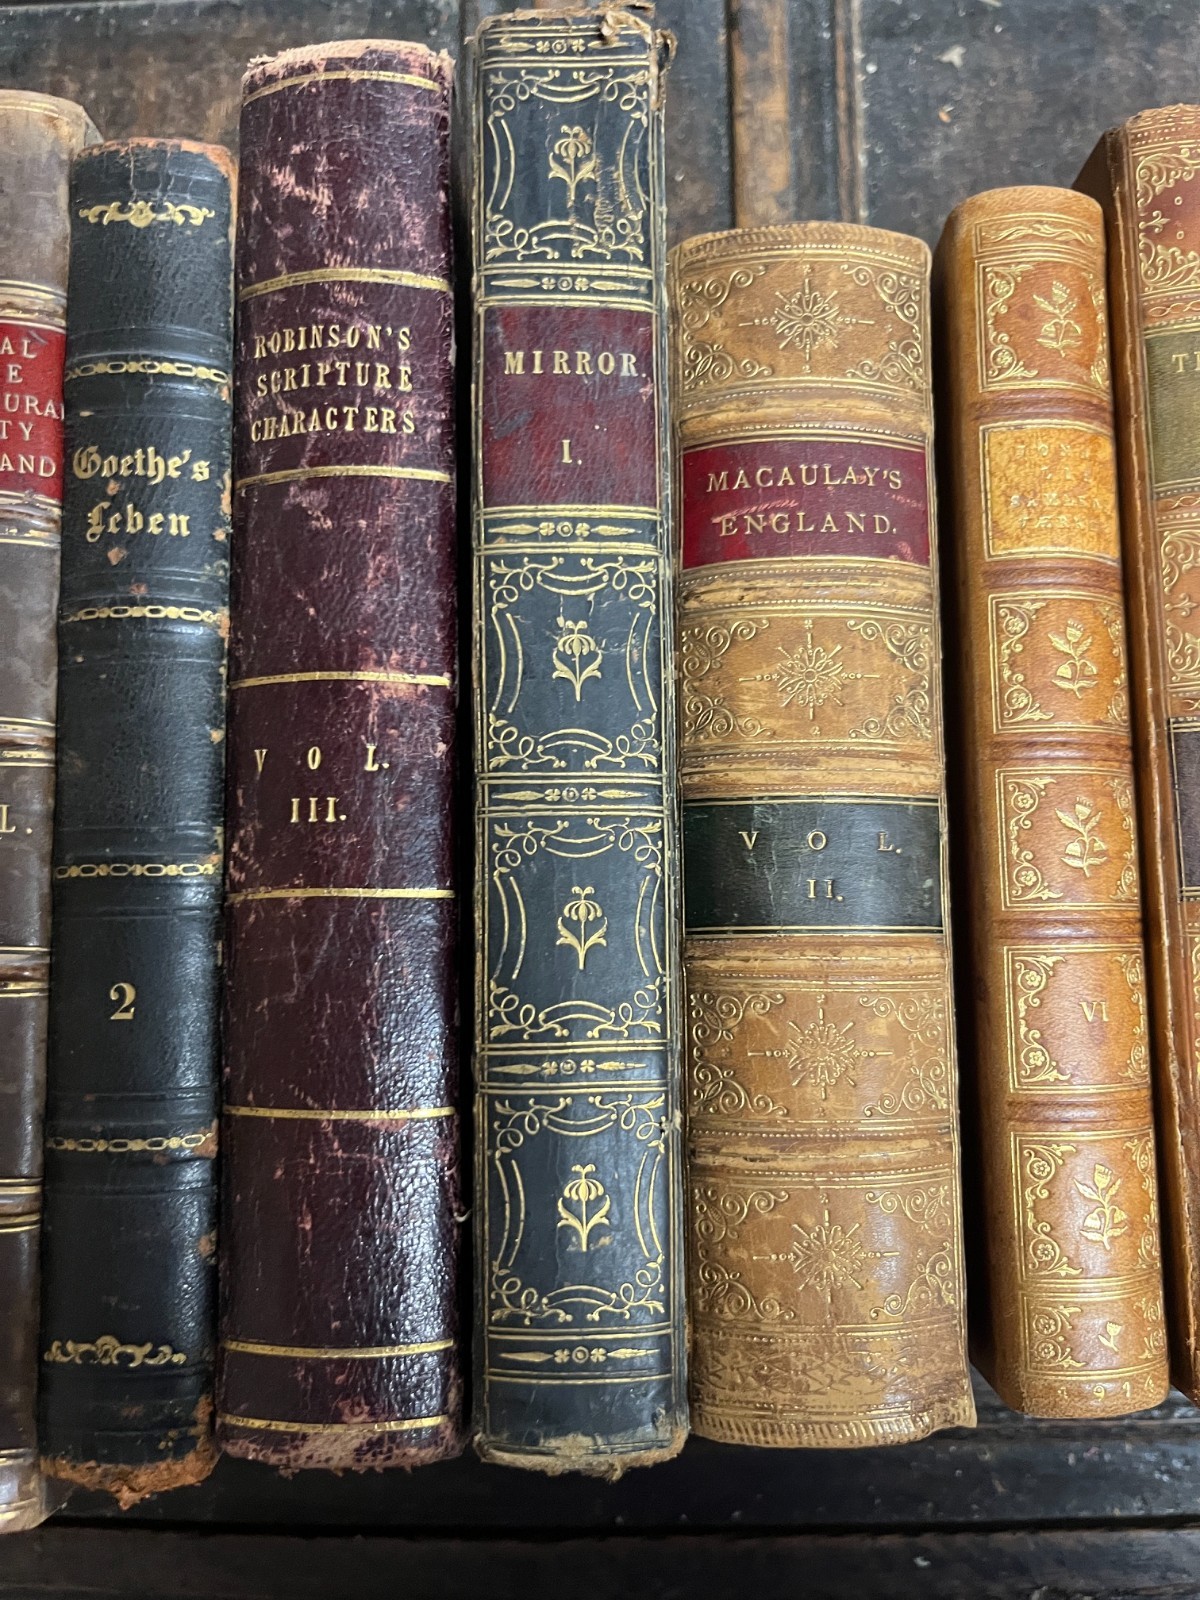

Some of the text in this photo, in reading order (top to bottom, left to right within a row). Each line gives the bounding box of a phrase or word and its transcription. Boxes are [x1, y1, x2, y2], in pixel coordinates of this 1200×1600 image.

[254, 324, 412, 359] ROBINSON'S
[504, 350, 647, 378] MIRROR.
[256, 361, 413, 398] SCRIPTURE
[251, 406, 416, 442] CHARACTERS
[72, 445, 211, 486] Goethe's
[561, 439, 583, 464] I.
[706, 463, 902, 493] MACAULAY'S
[85, 501, 191, 543] Leben
[719, 512, 898, 537] ENGLAND.
[289, 796, 348, 824] III.
[807, 879, 844, 902] II.
[109, 982, 137, 1021] 2
[1078, 1001, 1110, 1023] VI
